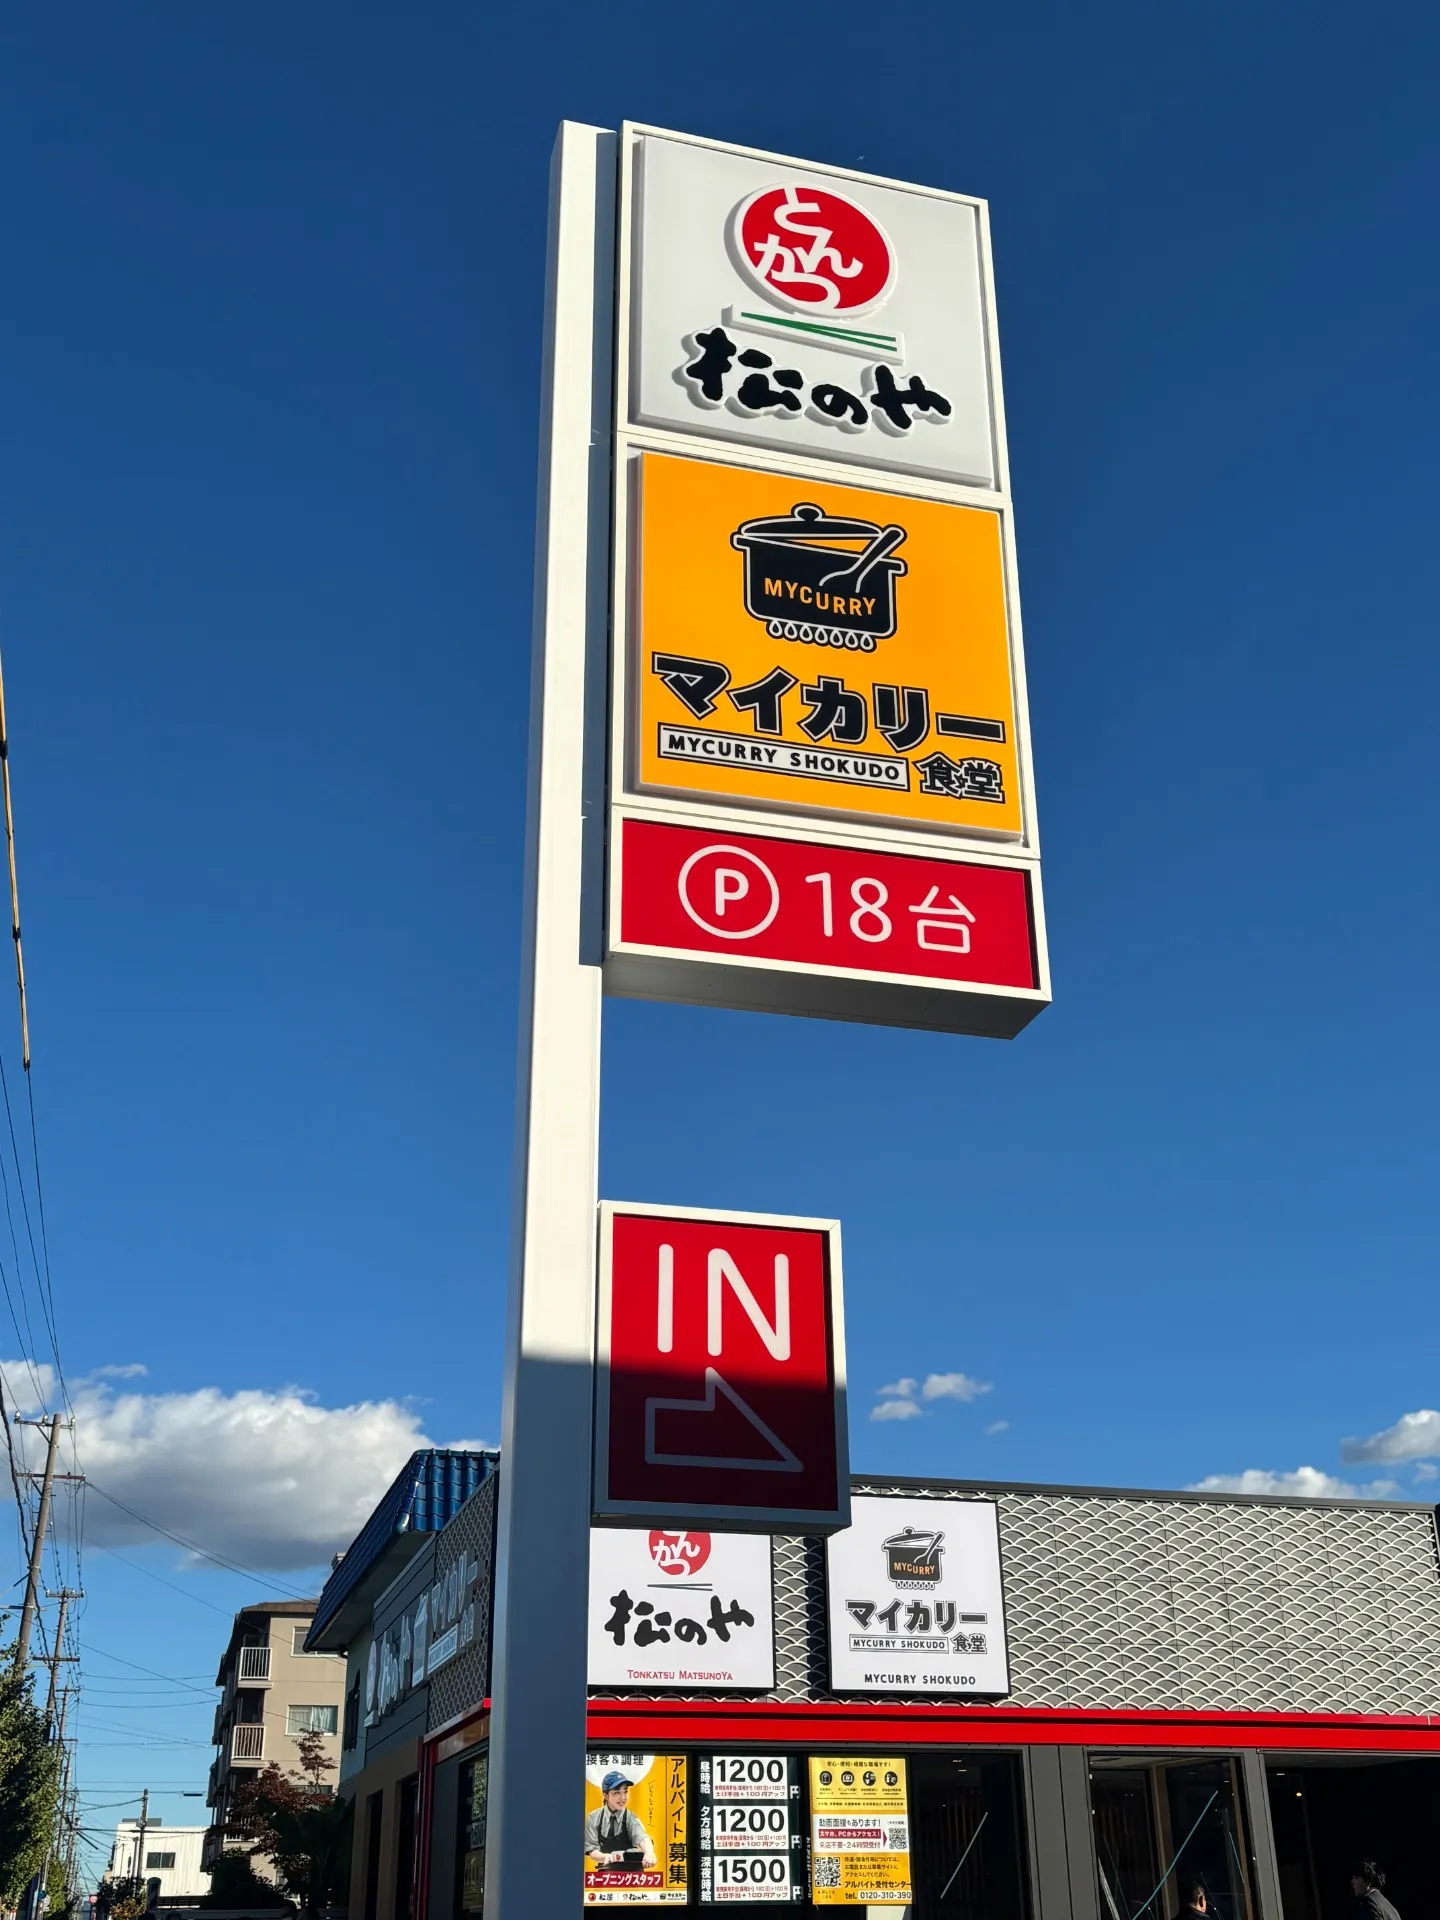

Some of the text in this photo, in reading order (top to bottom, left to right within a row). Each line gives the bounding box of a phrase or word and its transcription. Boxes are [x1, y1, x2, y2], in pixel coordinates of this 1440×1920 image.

[687, 327, 952, 430] 松のや
[764, 577, 876, 616] MYCURRY
[652, 651, 1006, 752] マイカリー
[668, 727, 901, 781] MYCURRY SHOKUDO
[915, 752, 1006, 804] 食堂
[657, 1243, 791, 1361] IN
[893, 1562, 935, 1575] MYCURRY
[604, 1589, 755, 1647] 松のや
[845, 1598, 988, 1634] マイカリー
[853, 1639, 945, 1649] MYCURRY SHOKUDO
[951, 1632, 988, 1654] 食堂
[864, 1674, 976, 1685] MYCURRY SHOKUDO
[716, 1759, 784, 1782] 1200
[700, 1806, 711, 1850] 夕方時給
[716, 1808, 785, 1832] 1200
[587, 1873, 662, 1886] オープニングスタッフ
[701, 1856, 712, 1901] 深夜時給
[718, 1859, 786, 1883] 1500
